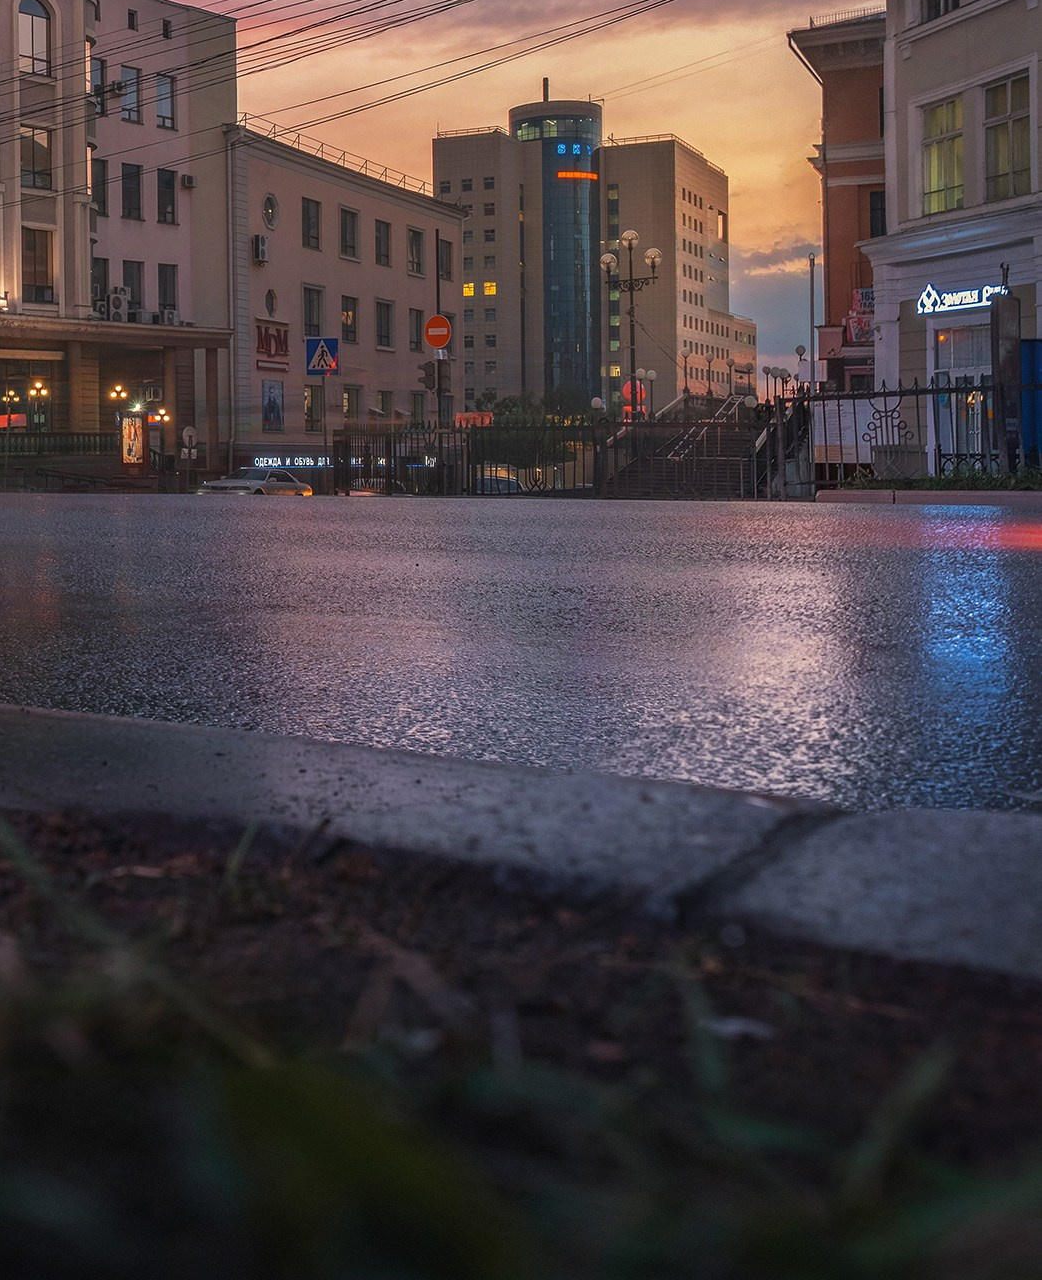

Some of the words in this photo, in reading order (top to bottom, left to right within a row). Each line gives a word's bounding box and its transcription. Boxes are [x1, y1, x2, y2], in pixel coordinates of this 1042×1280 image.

[254, 457, 282, 467] ОДЕЖДА
[285, 457, 291, 466] И
[294, 457, 315, 466] ОБУВЬ
